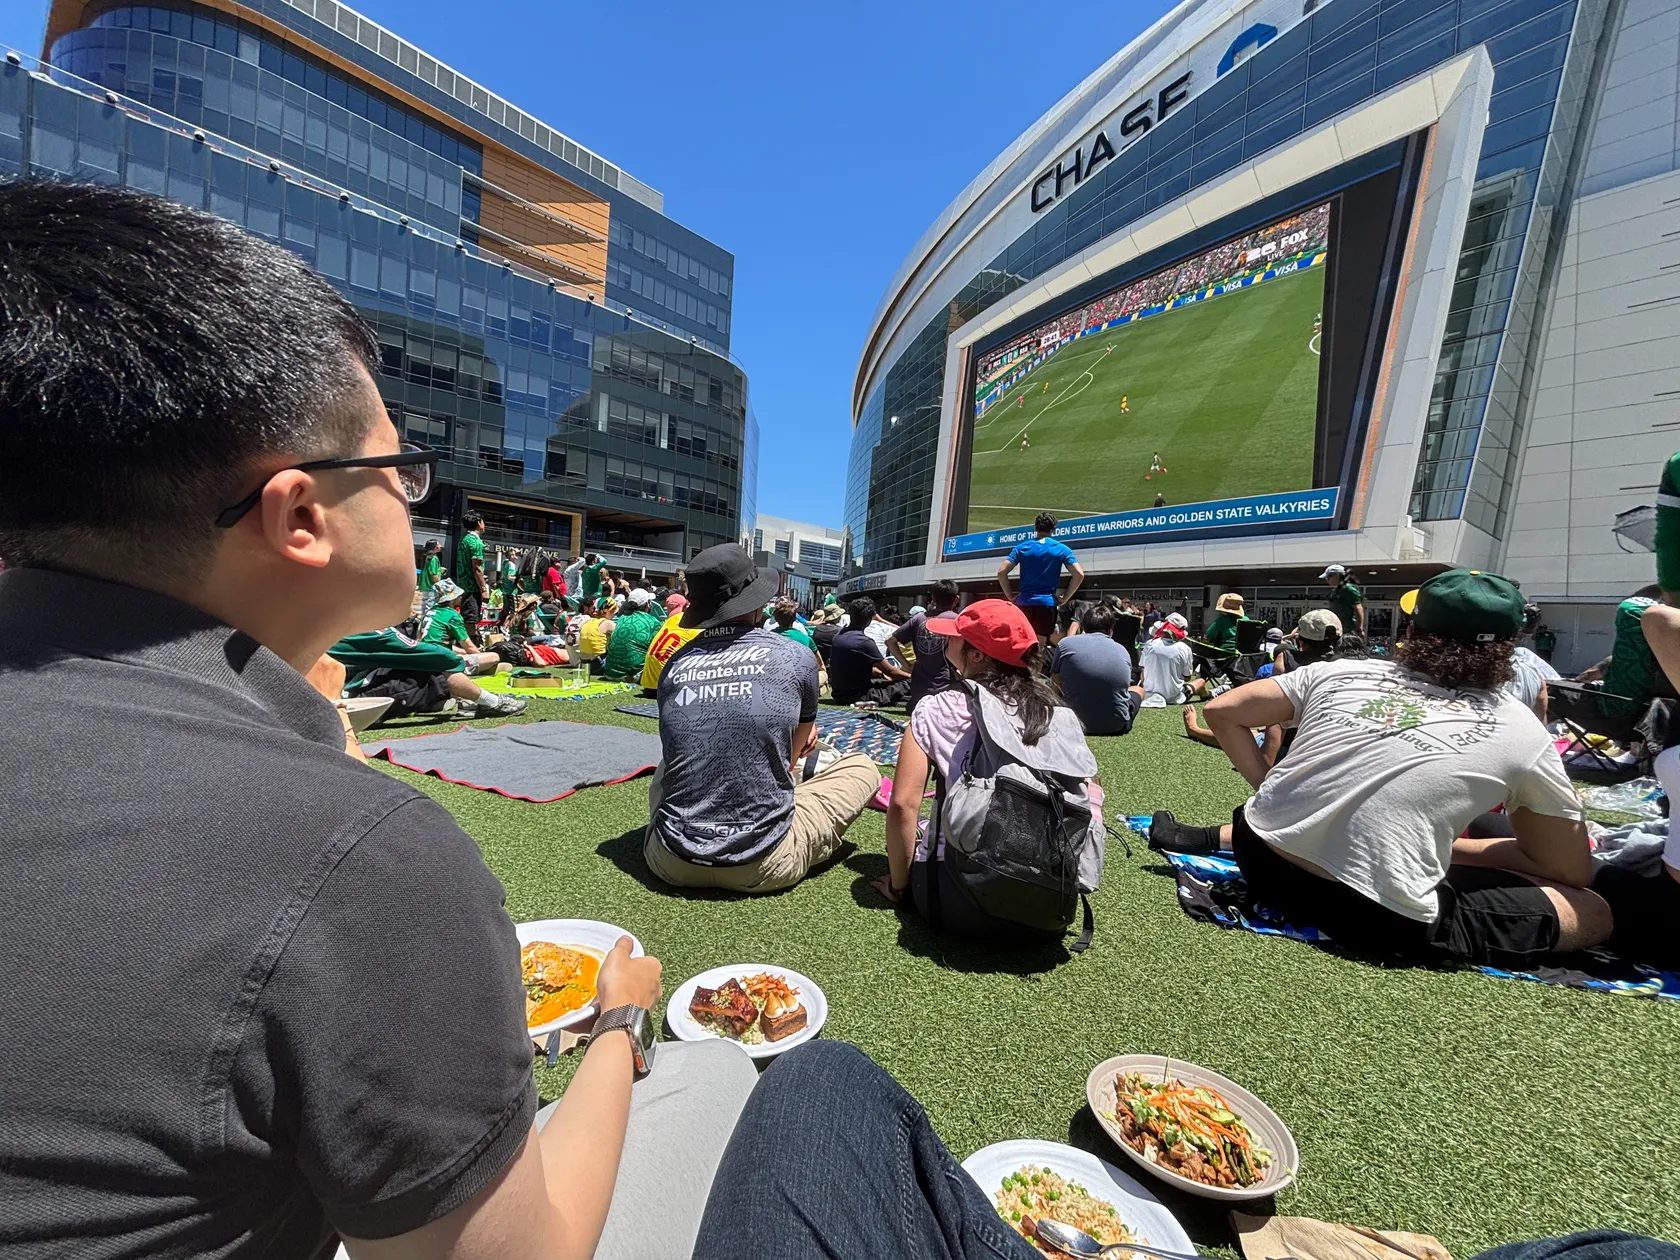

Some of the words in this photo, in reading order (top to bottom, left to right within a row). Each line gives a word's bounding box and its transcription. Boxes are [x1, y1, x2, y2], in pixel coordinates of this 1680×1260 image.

[1281, 228, 1309, 249] FOX
[1267, 249, 1284, 261] LIVE
[1274, 262, 1298, 276] VISA
[1222, 281, 1242, 293] VISA
[999, 533, 1016, 543] HOME
[1017, 532, 1026, 541] OF
[1051, 526, 1070, 537] LDEN
[1071, 523, 1095, 534] STATE
[1097, 518, 1144, 532] WARRIORS
[1145, 515, 1167, 526] AND
[1169, 510, 1213, 524] GOLDEN
[1216, 506, 1252, 519] STATE
[1255, 498, 1330, 516] VALKYRIES
[948, 538, 957, 549] 79
[703, 626, 736, 638] CHARLY
[673, 664, 765, 685] caliente.mx
[699, 681, 753, 699] INTER
